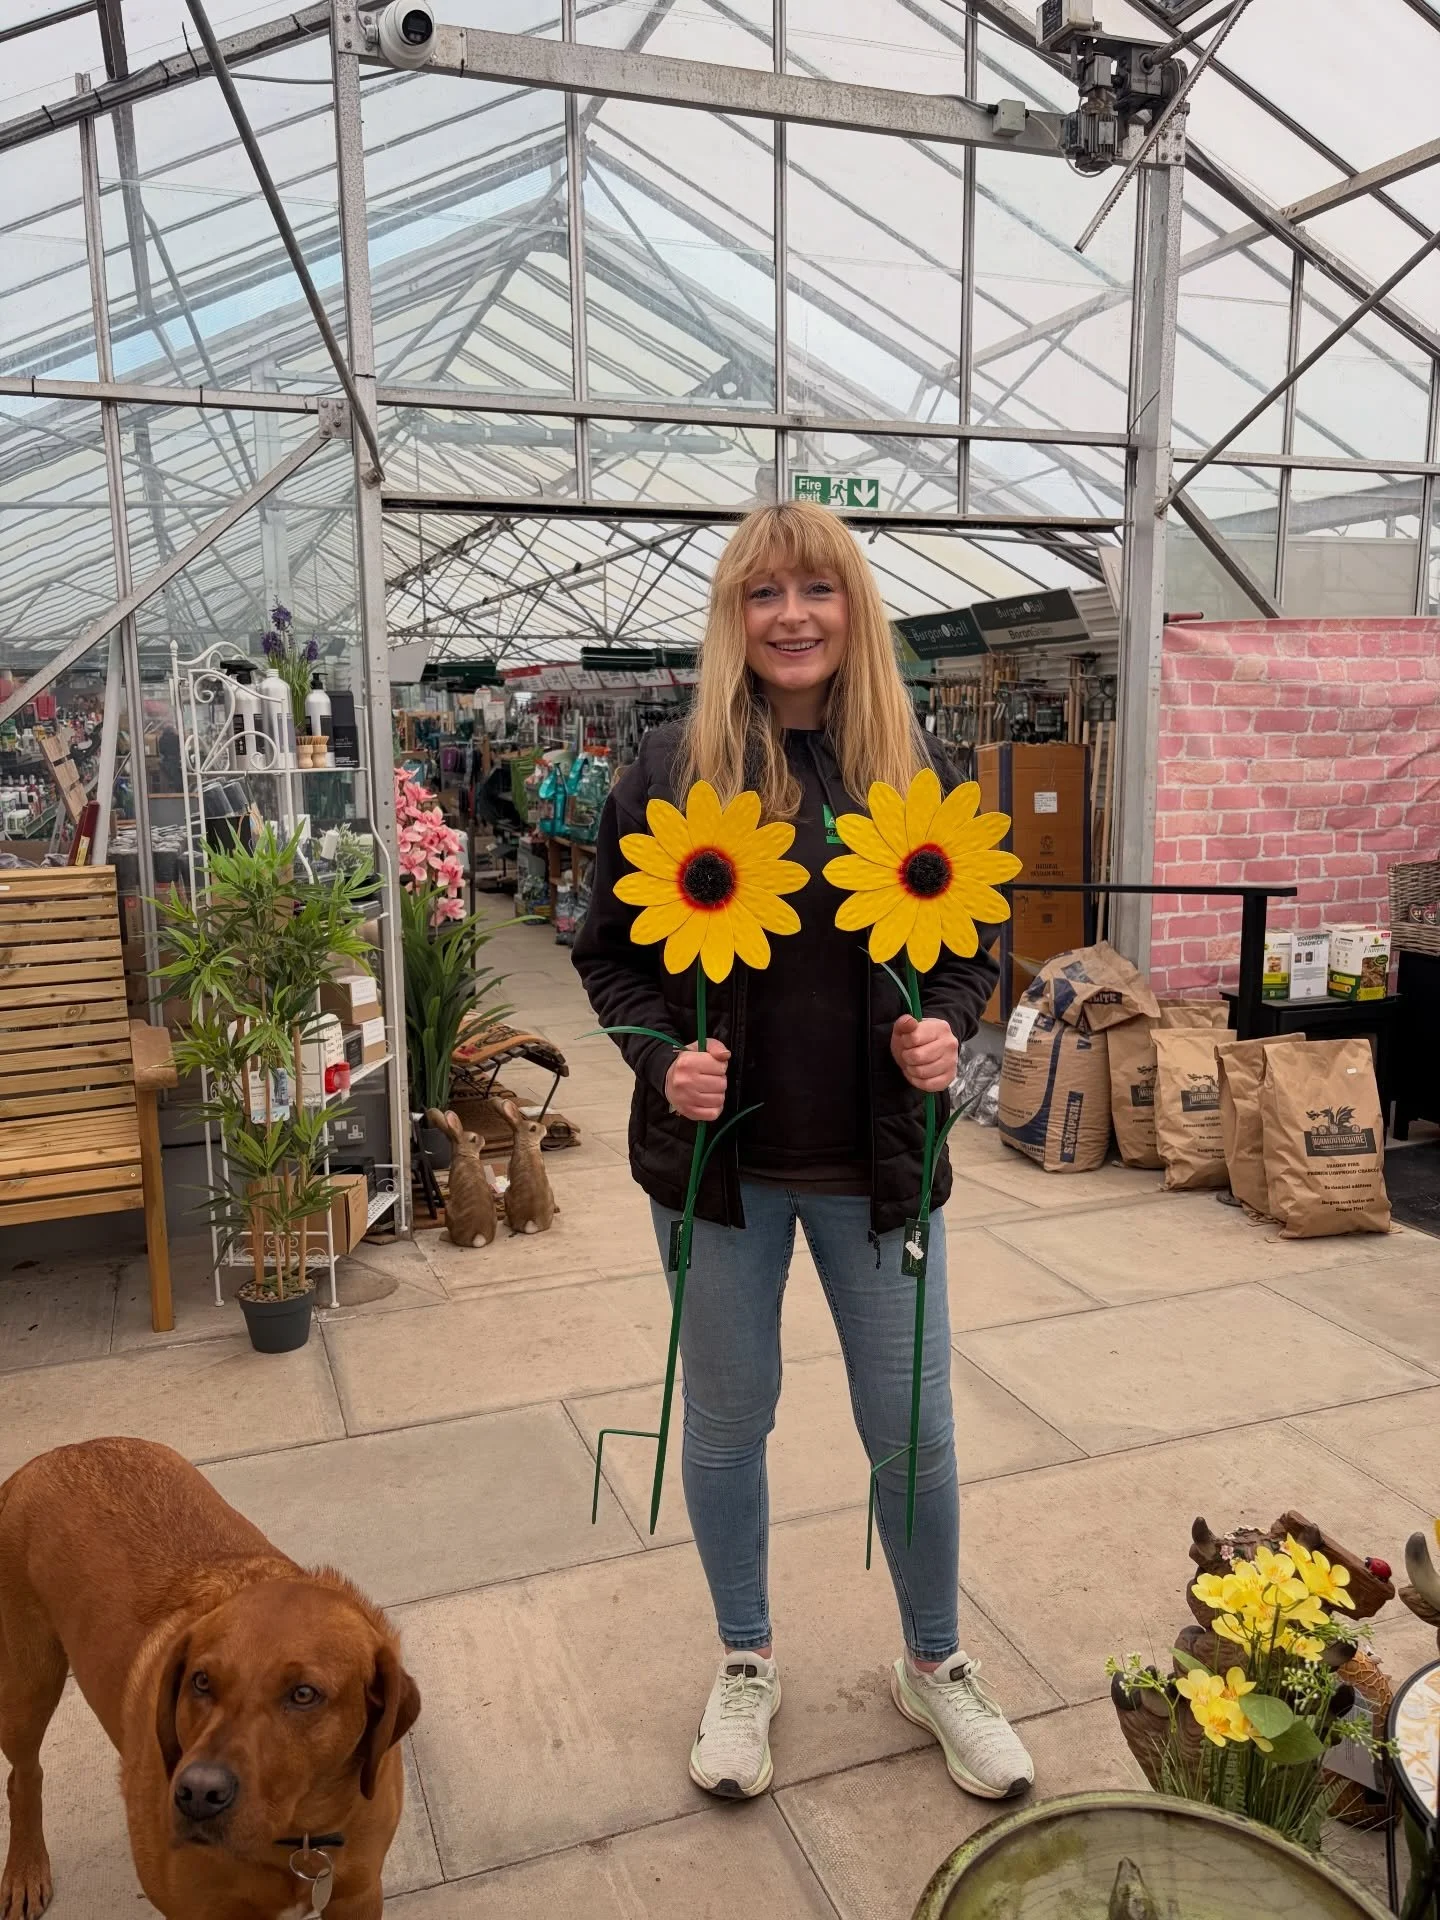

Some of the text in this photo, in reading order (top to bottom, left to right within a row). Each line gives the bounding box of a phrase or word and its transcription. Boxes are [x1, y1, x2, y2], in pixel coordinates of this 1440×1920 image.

[799, 478, 822, 491] Fire
[798, 491, 821, 502] exit
[947, 620, 969, 637] Ball
[1312, 1135, 1365, 1146] MONMOUTHSHIRE
